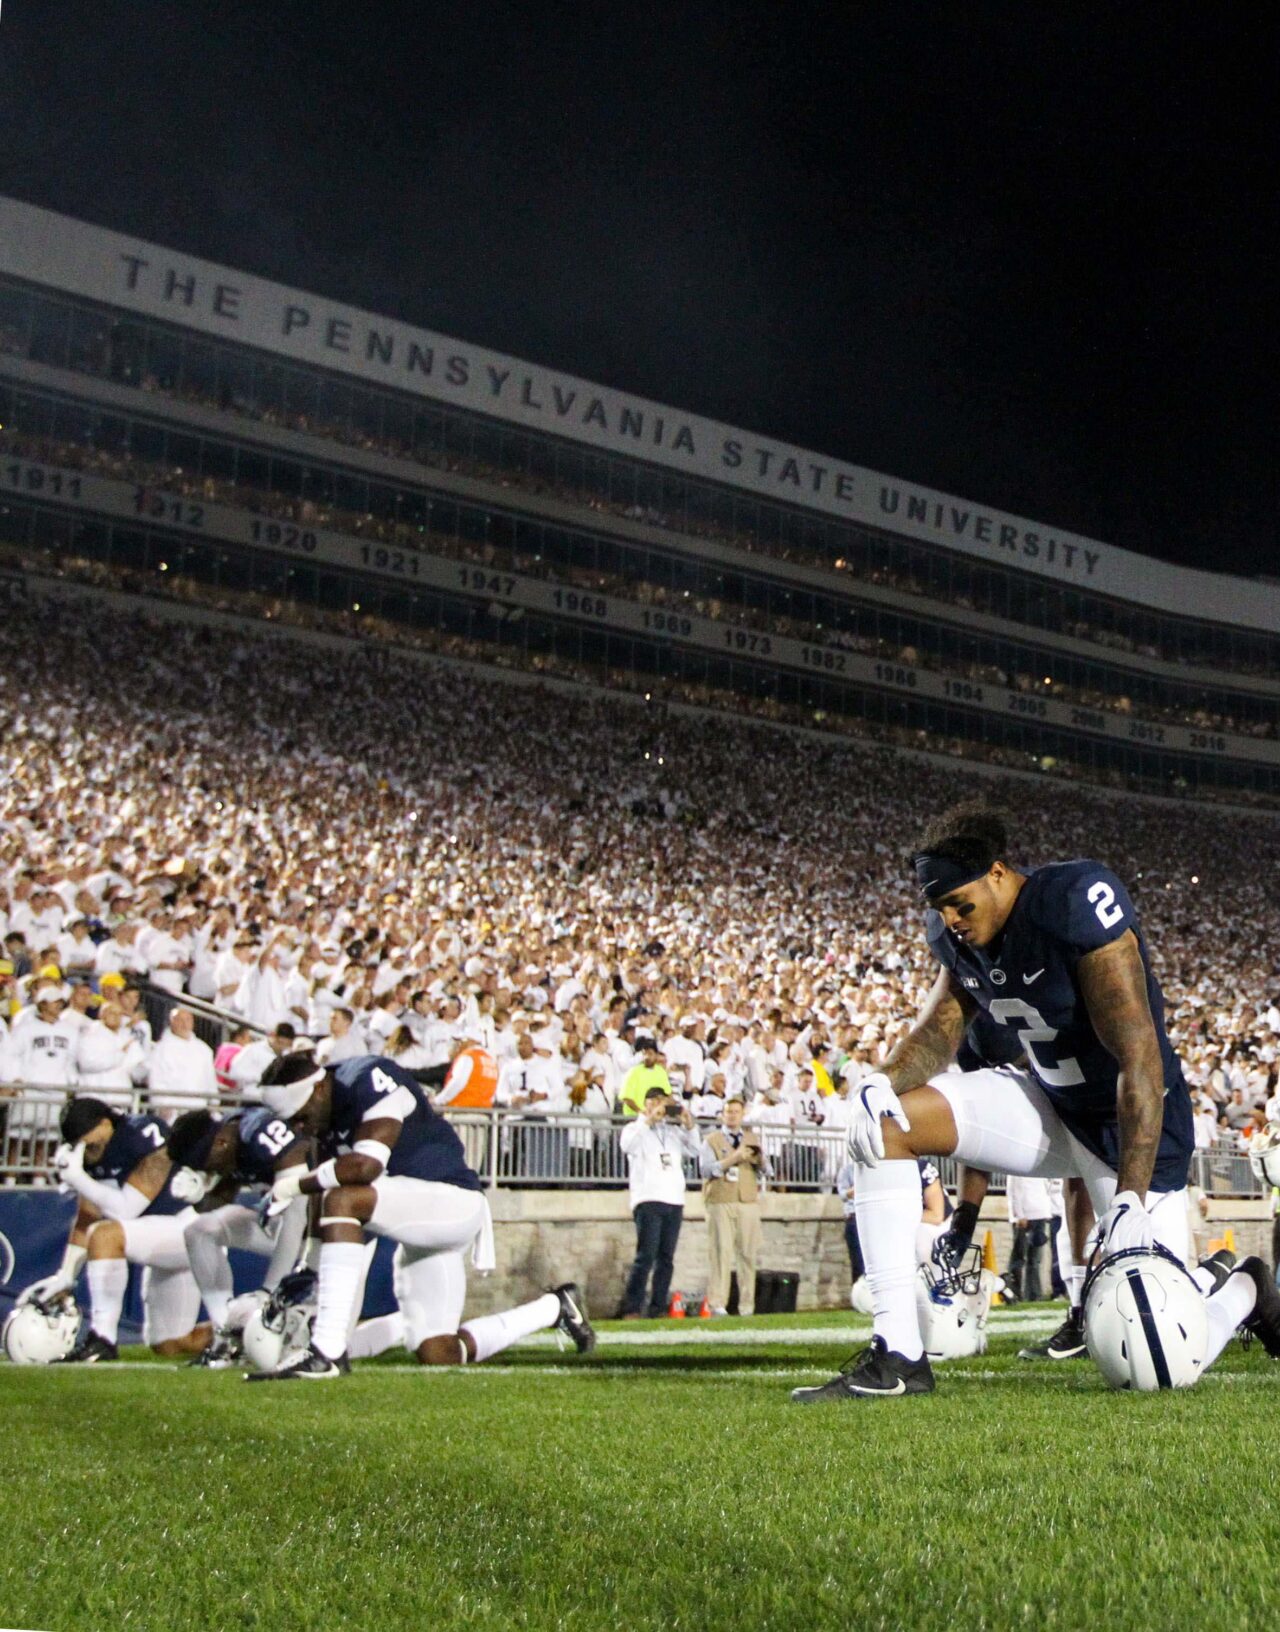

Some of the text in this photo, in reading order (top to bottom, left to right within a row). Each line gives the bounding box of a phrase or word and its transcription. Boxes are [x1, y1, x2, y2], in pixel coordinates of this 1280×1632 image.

[120, 254, 1100, 575] THE PENNSYLVANIA STATE UNIVERSITY
[7, 464, 82, 499] 1911
[253, 520, 317, 552] 1920
[360, 544, 418, 576] 1921
[459, 568, 515, 595] 1947
[724, 629, 772, 655] 1973
[802, 646, 846, 672] 1982
[1190, 733, 1226, 751] 2016
[1088, 881, 1123, 929] 2
[989, 998, 1086, 1087] 2
[371, 1066, 399, 1094] 4
[520, 1071, 527, 1091] 1
[141, 1122, 166, 1148] 7
[257, 1119, 296, 1156] 12
